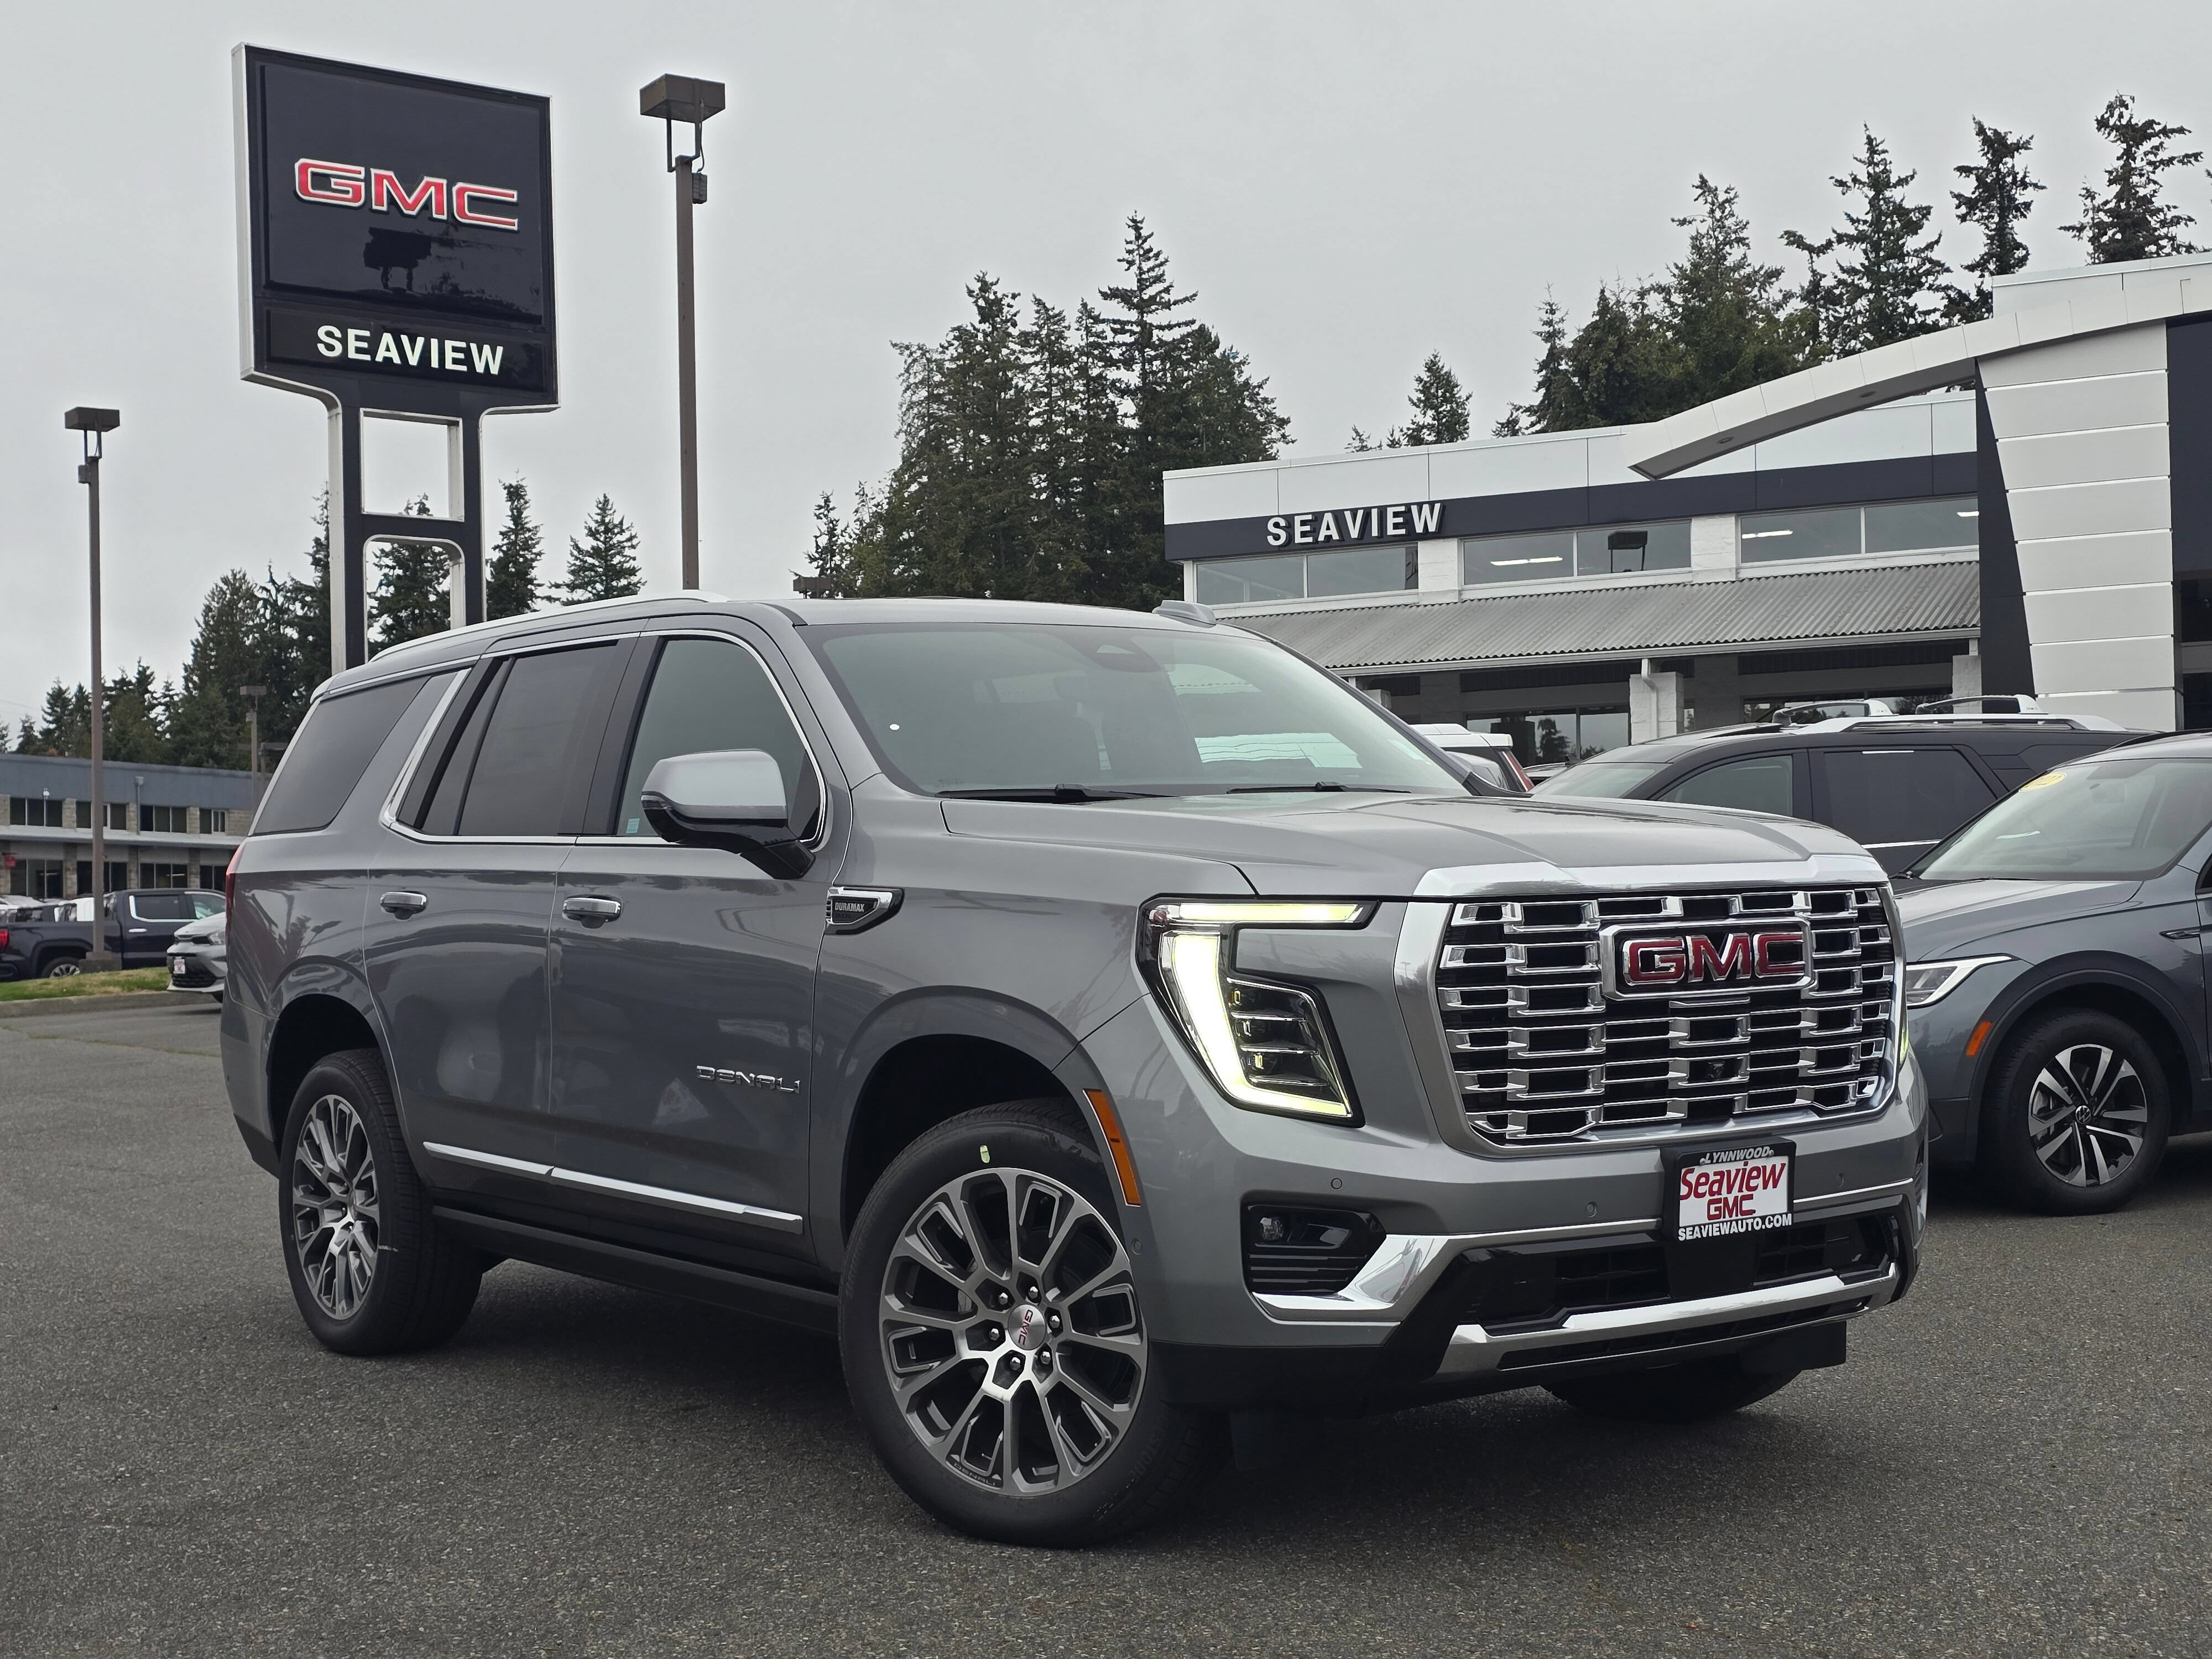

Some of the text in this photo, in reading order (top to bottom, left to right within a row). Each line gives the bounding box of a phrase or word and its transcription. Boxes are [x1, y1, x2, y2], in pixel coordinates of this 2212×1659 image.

[294, 158, 518, 231] GMC
[316, 325, 504, 375] SEAVIEW
[1266, 503, 1442, 546] SEAVIEW
[834, 902, 865, 912] DURAMAX
[1623, 932, 1806, 987] GMC
[696, 1065, 800, 1094] DENALI
[1704, 1146, 1770, 1164] LYNNWOOD
[1679, 1161, 1786, 1201] Seaview
[1707, 1193, 1755, 1221] GMC
[1678, 1213, 1792, 1241] SEAVIEWAUTO.COM
[1018, 1308, 1034, 1346] GMC
[953, 1462, 995, 1486] DENALI
